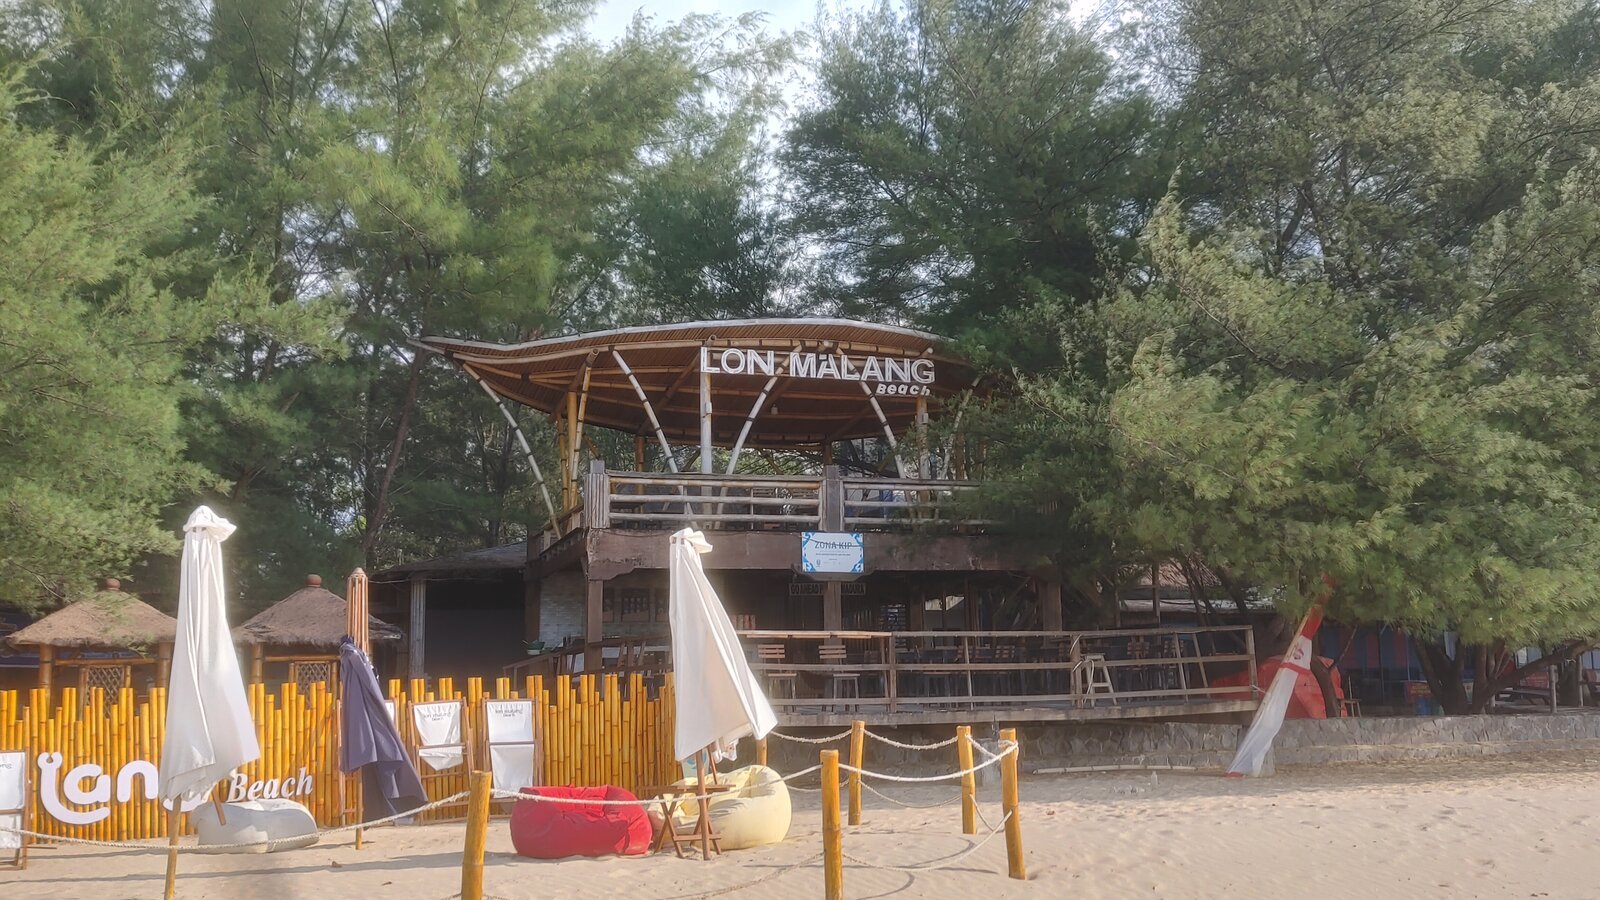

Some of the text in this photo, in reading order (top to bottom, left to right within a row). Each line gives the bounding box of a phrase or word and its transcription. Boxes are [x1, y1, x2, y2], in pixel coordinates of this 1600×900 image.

[701, 347, 935, 383] LON MALANG
[875, 382, 931, 397] Beach
[815, 541, 837, 549] ZONA
[227, 767, 313, 803] Beach
